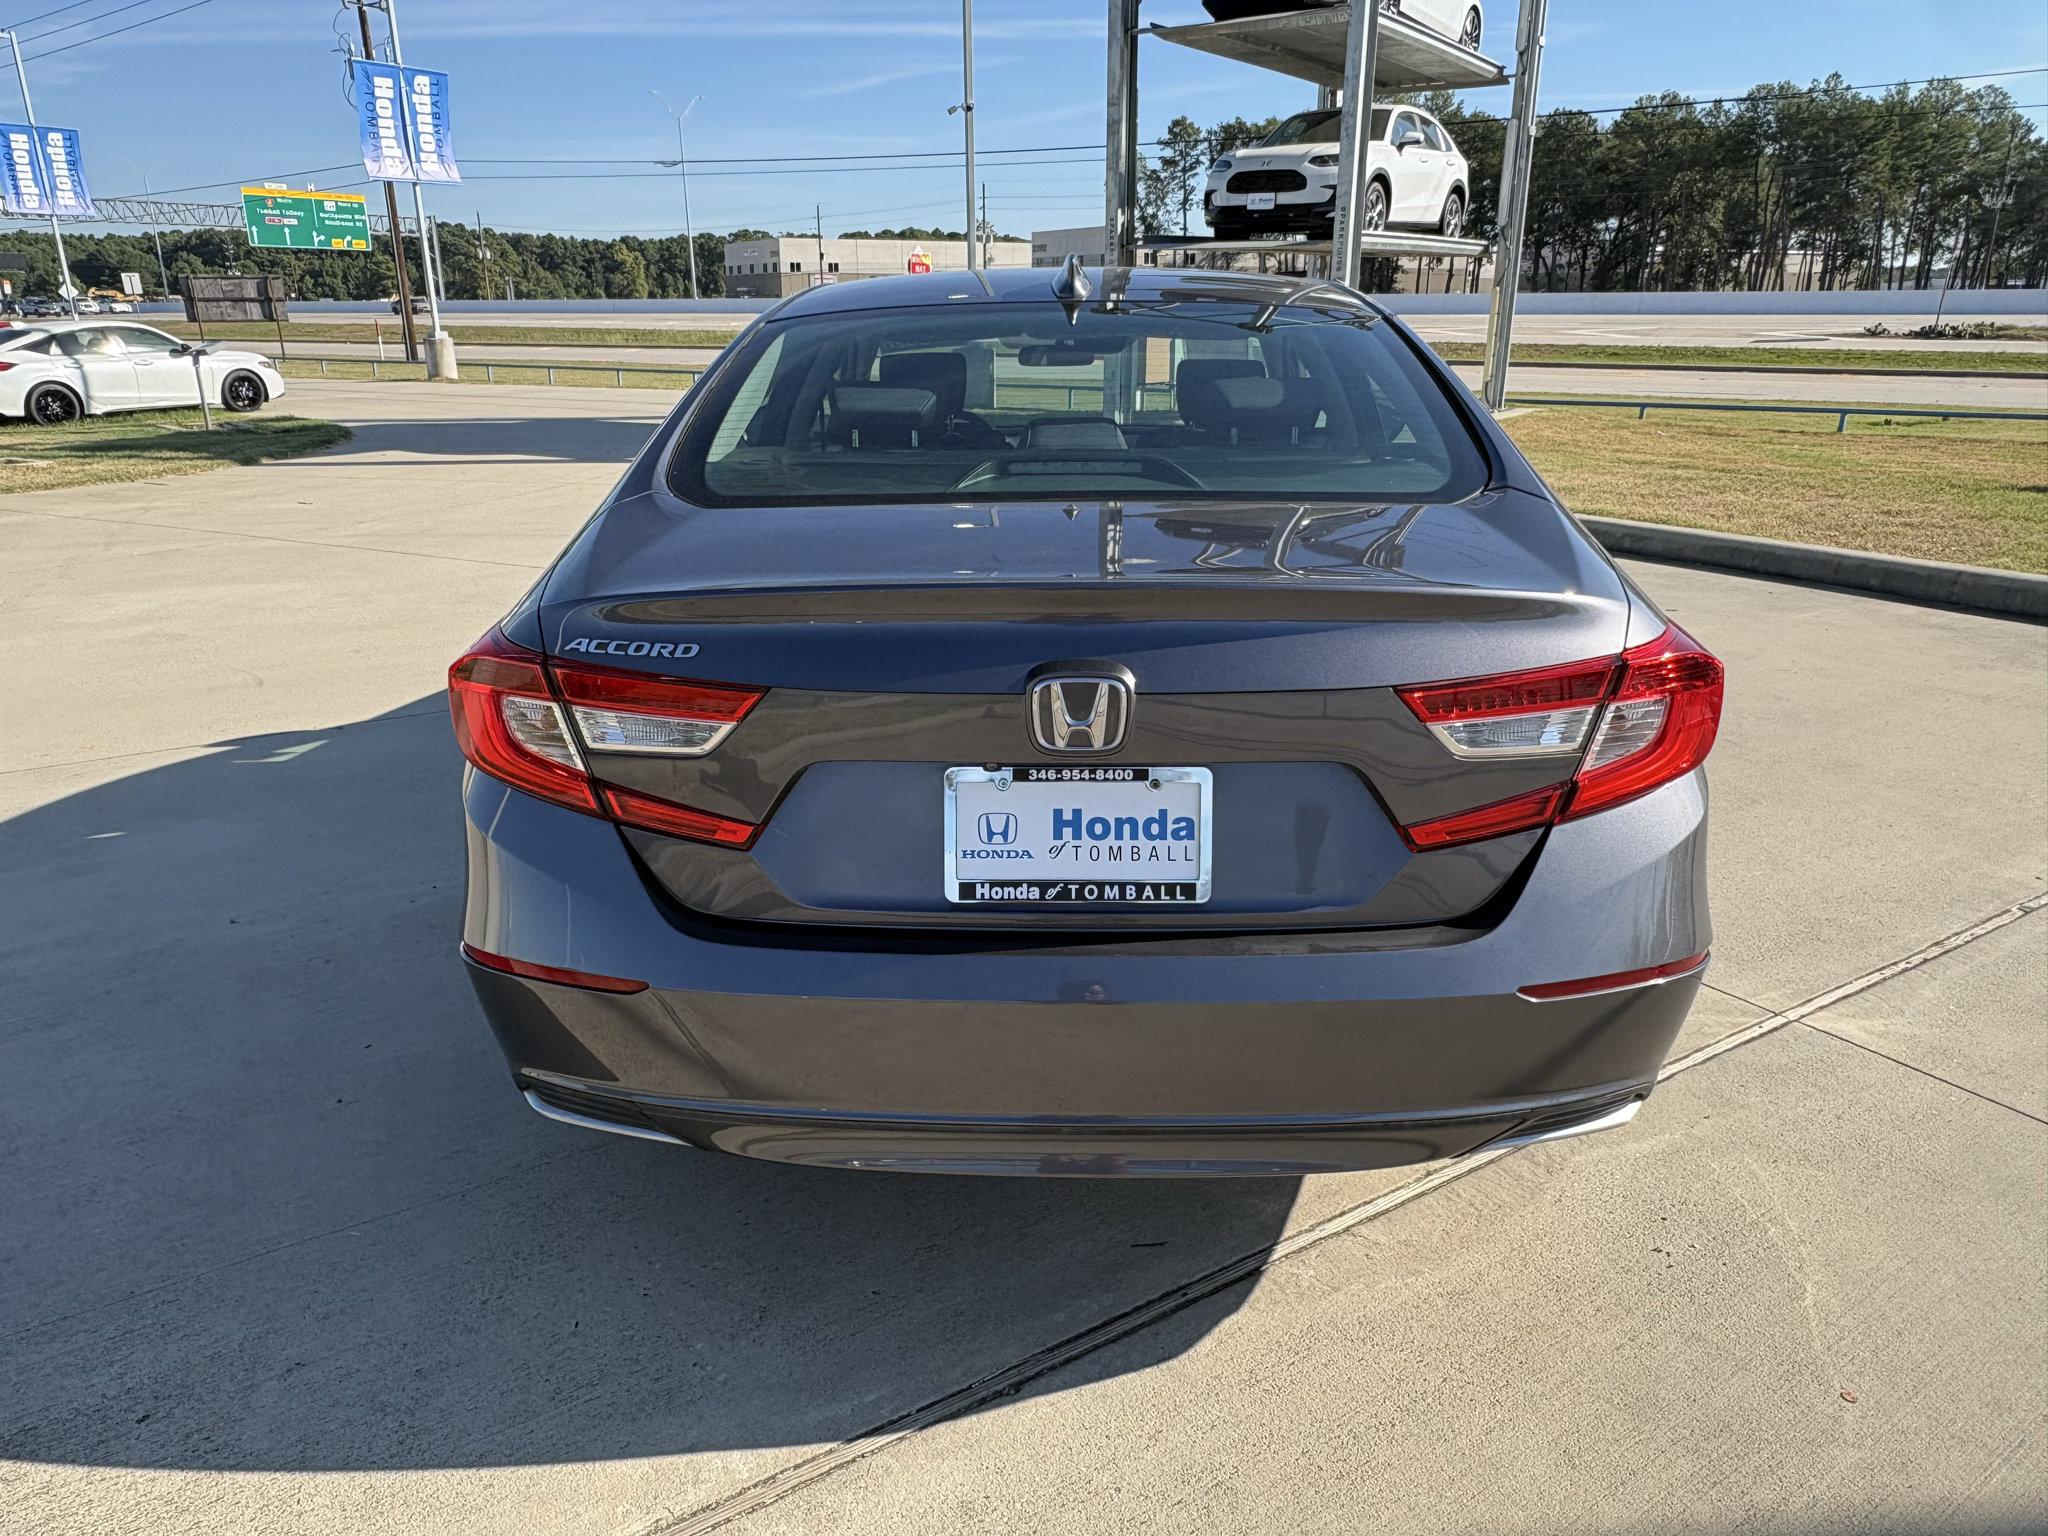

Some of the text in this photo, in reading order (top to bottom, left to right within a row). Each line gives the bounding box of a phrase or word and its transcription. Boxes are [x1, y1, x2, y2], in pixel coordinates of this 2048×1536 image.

[373, 76, 402, 177] Honda
[412, 75, 440, 172] Honda
[9, 133, 40, 209] Honda
[46, 132, 77, 206] Honda
[564, 637, 700, 658] ACCORD
[1028, 769, 1134, 781] 346-954-8400
[1052, 808, 1196, 841] Honda
[961, 849, 1034, 859] HONDA
[1049, 841, 1194, 862] of TOMBALL
[975, 883, 1186, 900] Honda of TOMBALL
